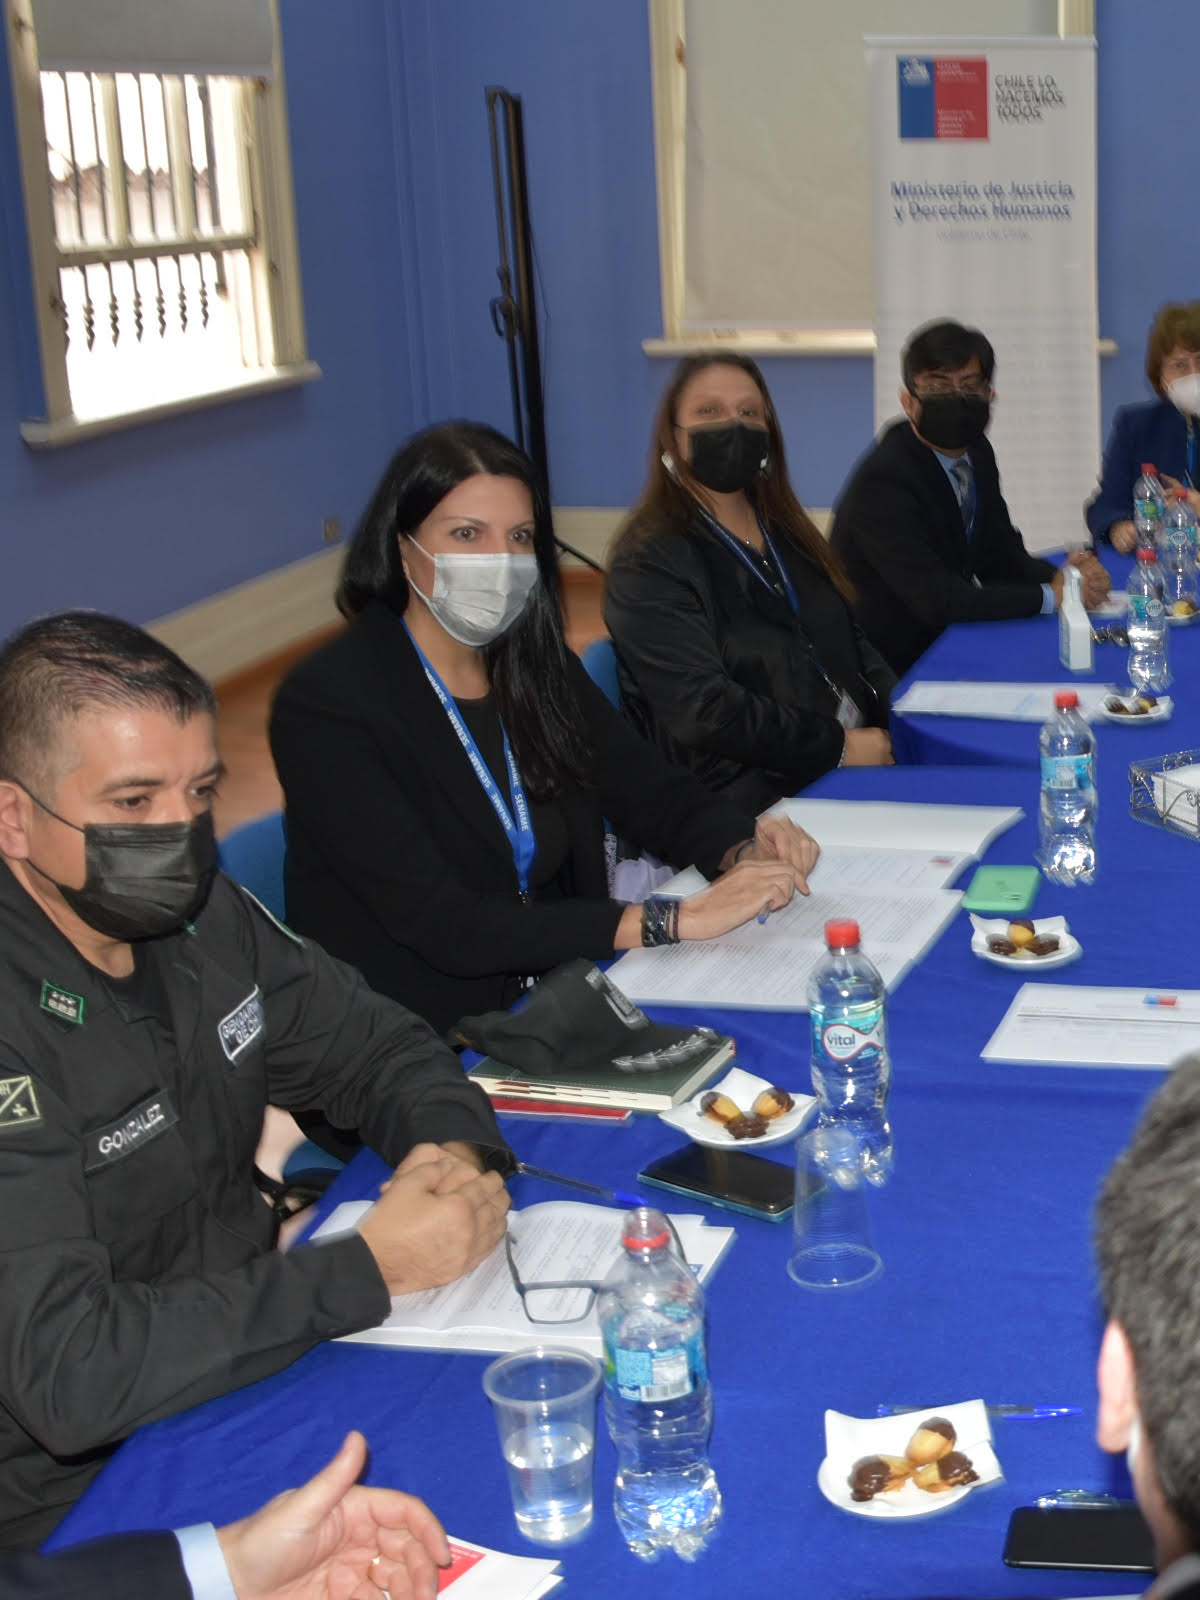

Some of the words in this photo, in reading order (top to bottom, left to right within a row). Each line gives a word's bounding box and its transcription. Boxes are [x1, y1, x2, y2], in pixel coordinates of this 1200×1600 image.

[995, 74, 1034, 88] CHILE
[1038, 74, 1057, 88] LO
[995, 90, 1065, 104] HACEMOS
[997, 105, 1042, 120] TODOS
[890, 180, 979, 201] Ministerio
[982, 181, 1006, 200] de
[1009, 180, 1075, 201] Justicia
[908, 201, 987, 219] Derechos
[991, 201, 1072, 219] Humanos
[447, 708, 471, 747] SENAME
[468, 750, 492, 789] SENAME
[491, 792, 513, 831] SENAME
[514, 793, 529, 832] SENAME
[827, 1032, 856, 1046] vital
[98, 1103, 165, 1154] GONZALEZ
